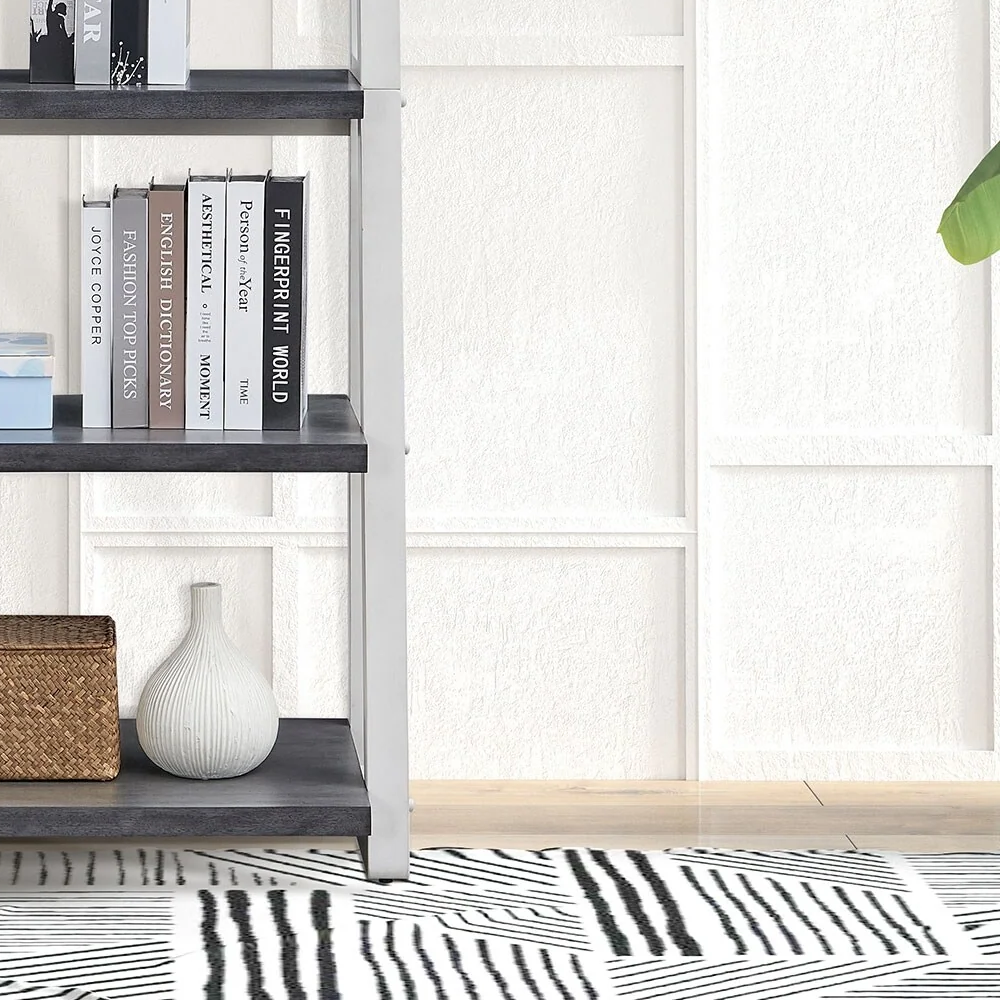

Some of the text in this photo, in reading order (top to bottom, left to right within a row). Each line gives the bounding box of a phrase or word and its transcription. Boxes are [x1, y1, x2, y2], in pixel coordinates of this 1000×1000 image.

[200, 194, 213, 293] AESTHETICAL
[238, 254, 247, 265] of
[239, 200, 253, 253] Person
[90, 226, 102, 345] JOYCE COPPER
[122, 230, 137, 400] FASHION TOP PICKS
[159, 212, 173, 410] ENGLISH DICTIONARY
[238, 278, 252, 313] Year
[272, 208, 290, 403] FINGERPRINT WORLD
[199, 354, 211, 419] MOMENT
[240, 379, 249, 405] TIME
